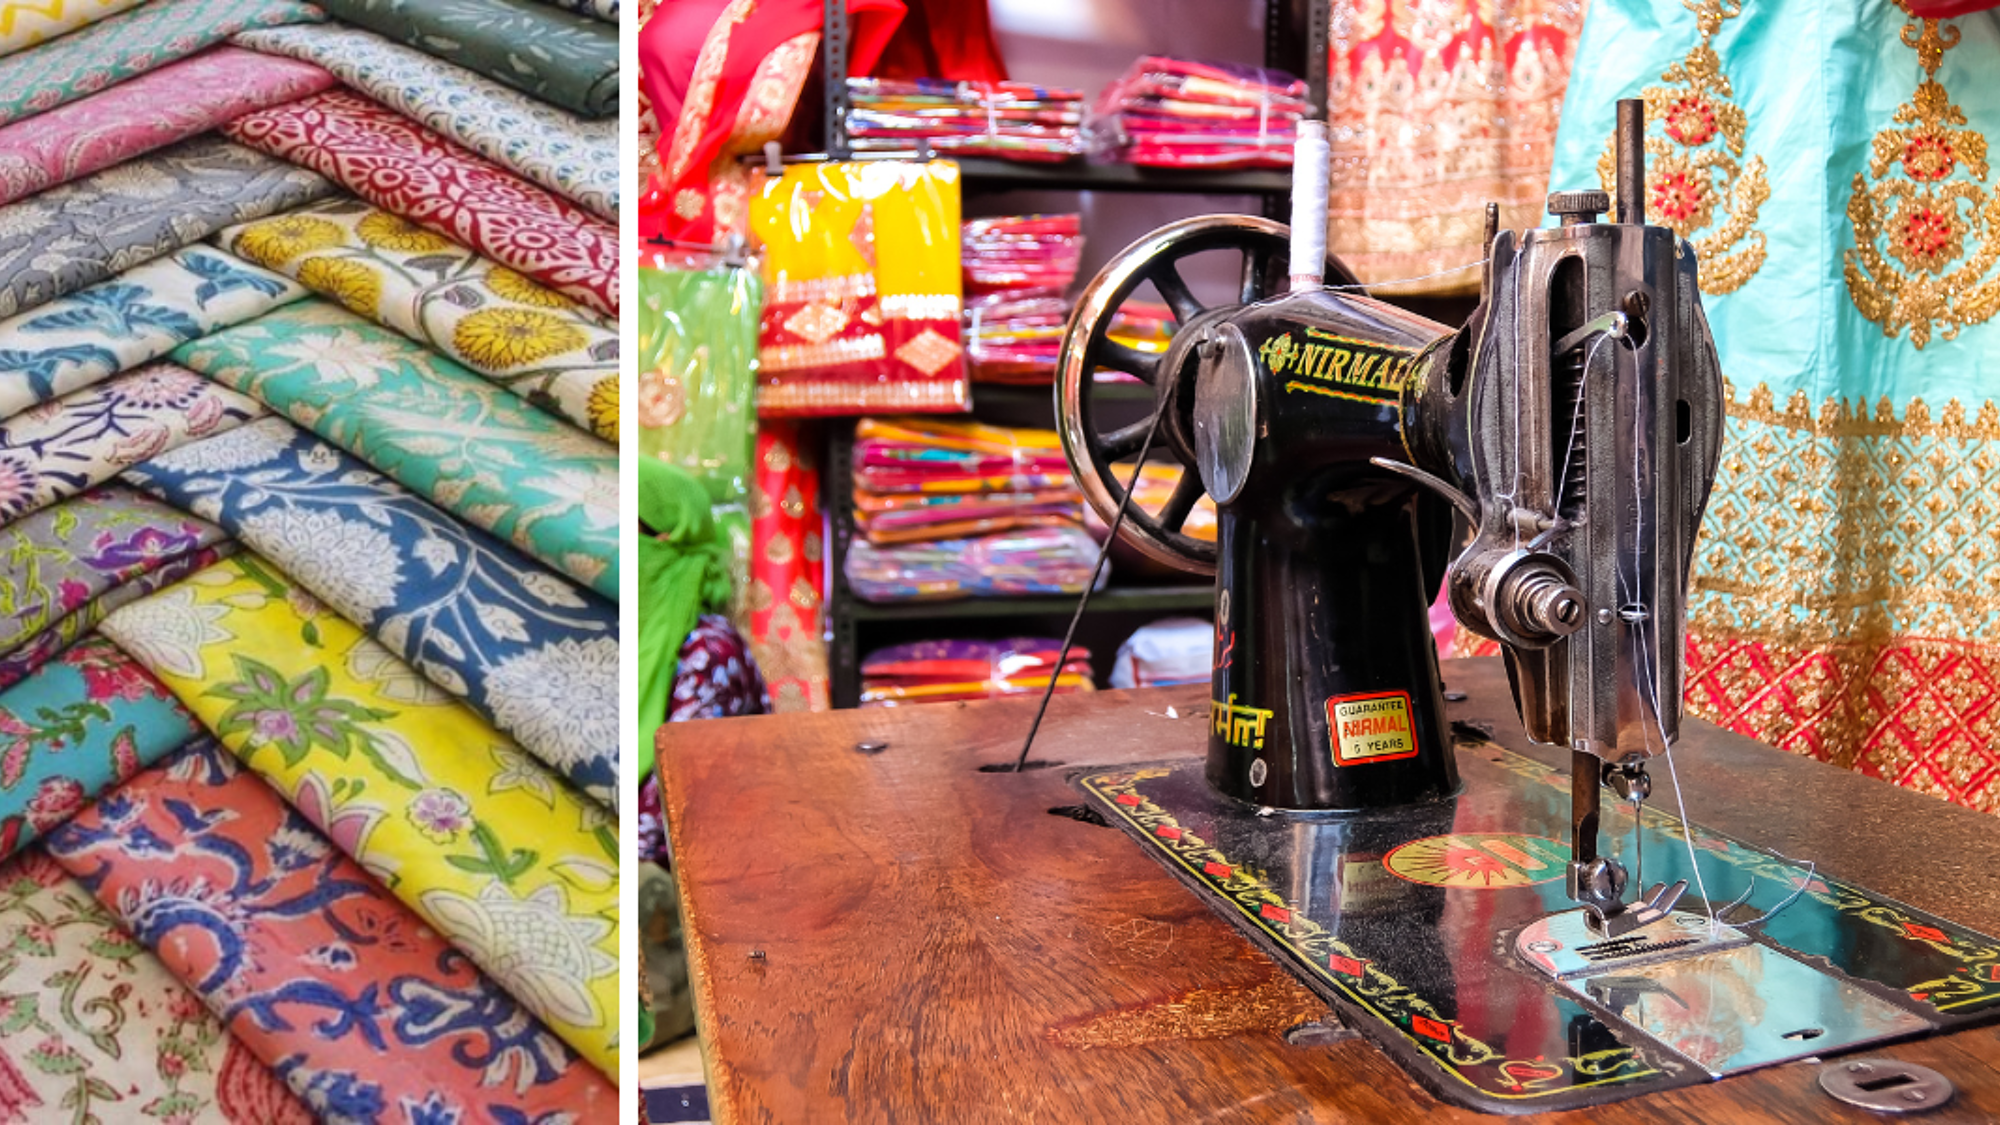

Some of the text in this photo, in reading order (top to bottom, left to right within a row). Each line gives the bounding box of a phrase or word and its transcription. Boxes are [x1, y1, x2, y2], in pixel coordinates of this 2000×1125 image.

[1295, 343, 1406, 391] NIRMAL
[1339, 700, 1404, 716] GUARANTEE
[1343, 715, 1407, 739] NIRMAL
[1367, 739, 1404, 751] YEARS
